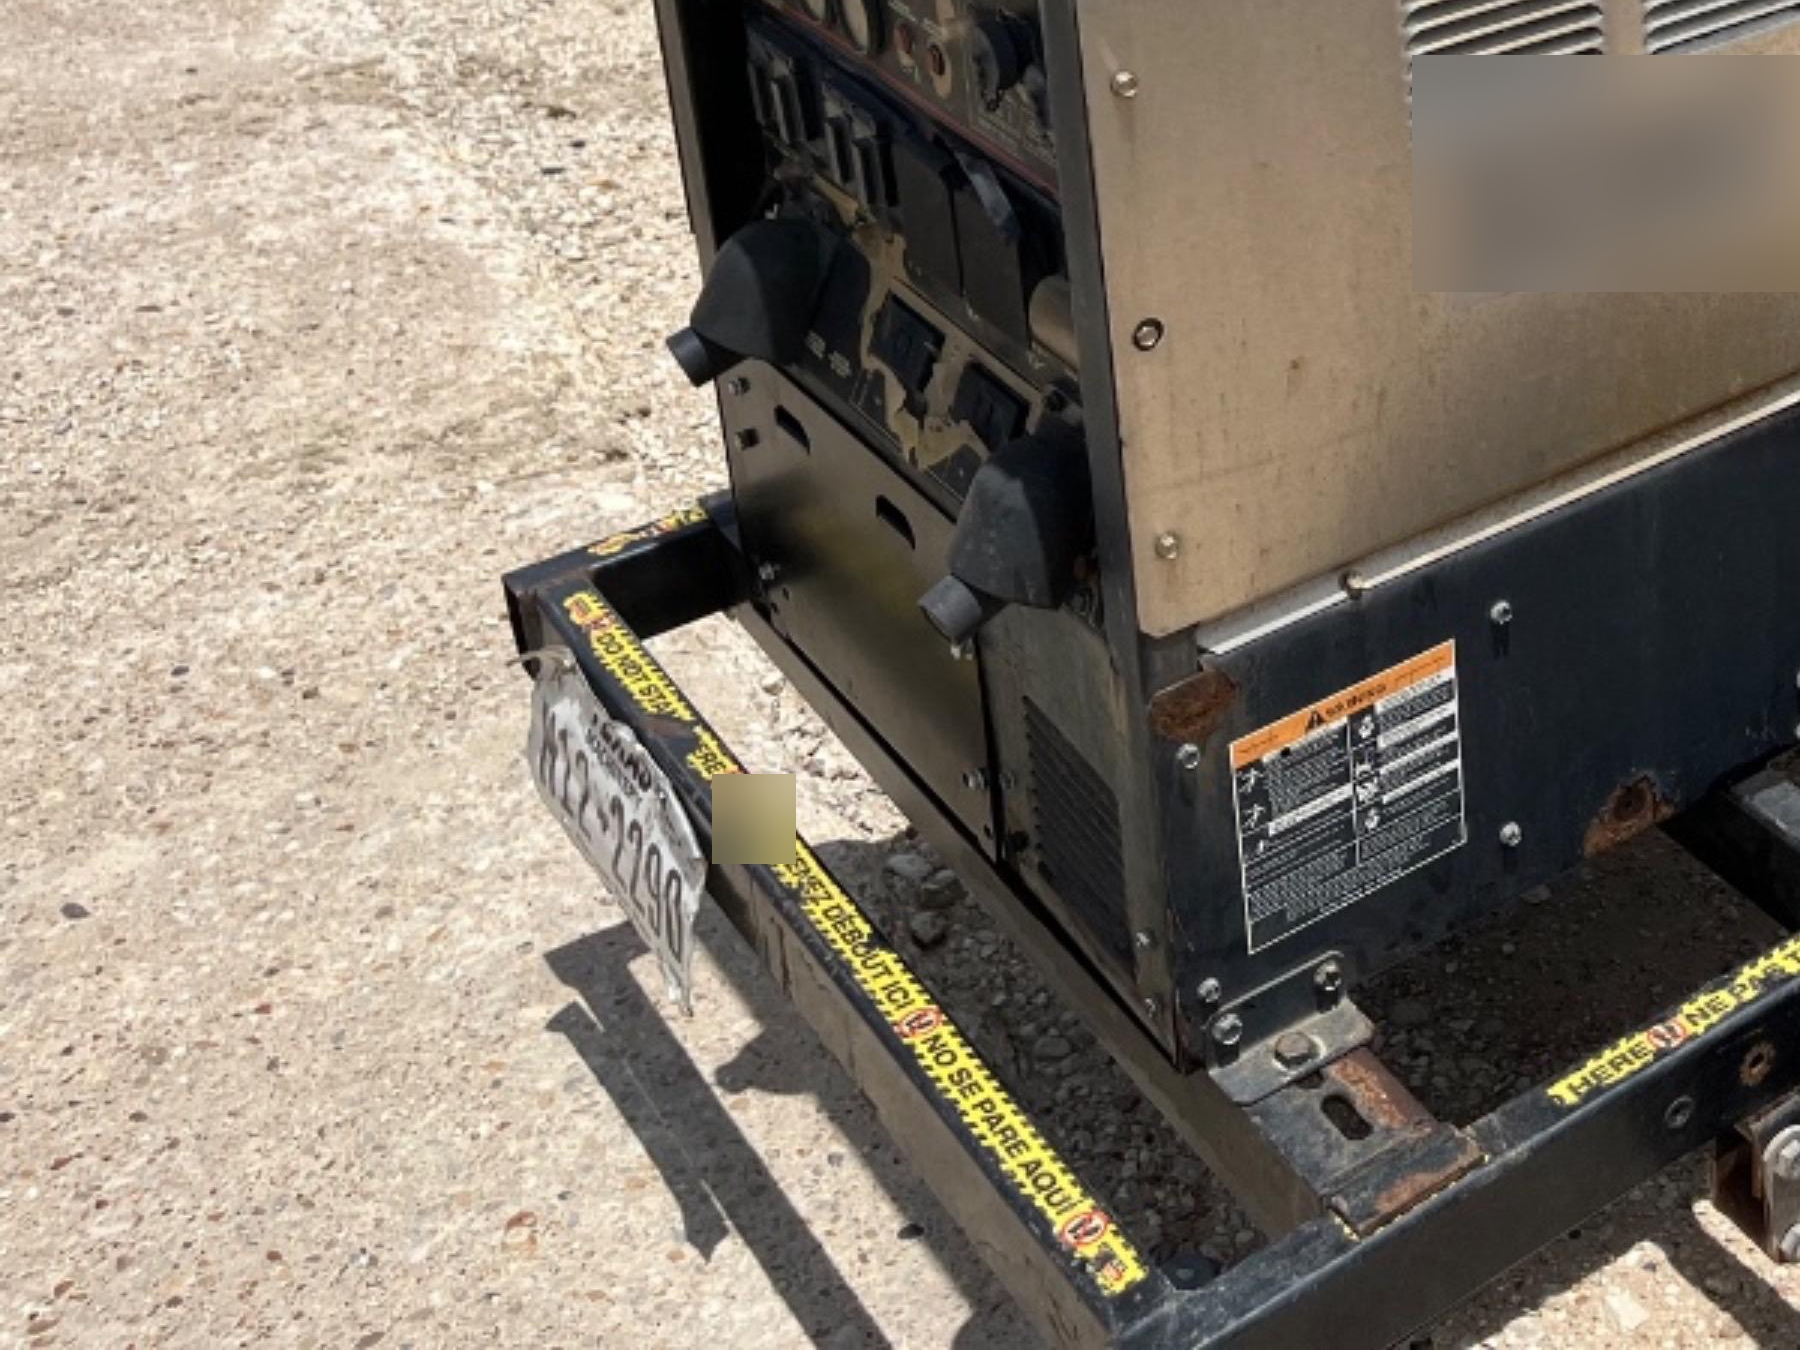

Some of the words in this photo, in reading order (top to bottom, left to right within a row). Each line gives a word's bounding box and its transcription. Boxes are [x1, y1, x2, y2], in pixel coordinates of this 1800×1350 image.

[880, 980, 916, 1011] ICI
[1685, 994, 1730, 1027] NE
[1566, 1038, 1650, 1095] HERE
[921, 1034, 958, 1067] NO
[948, 1068, 984, 1099] SE
[973, 1098, 1030, 1158] PARE
